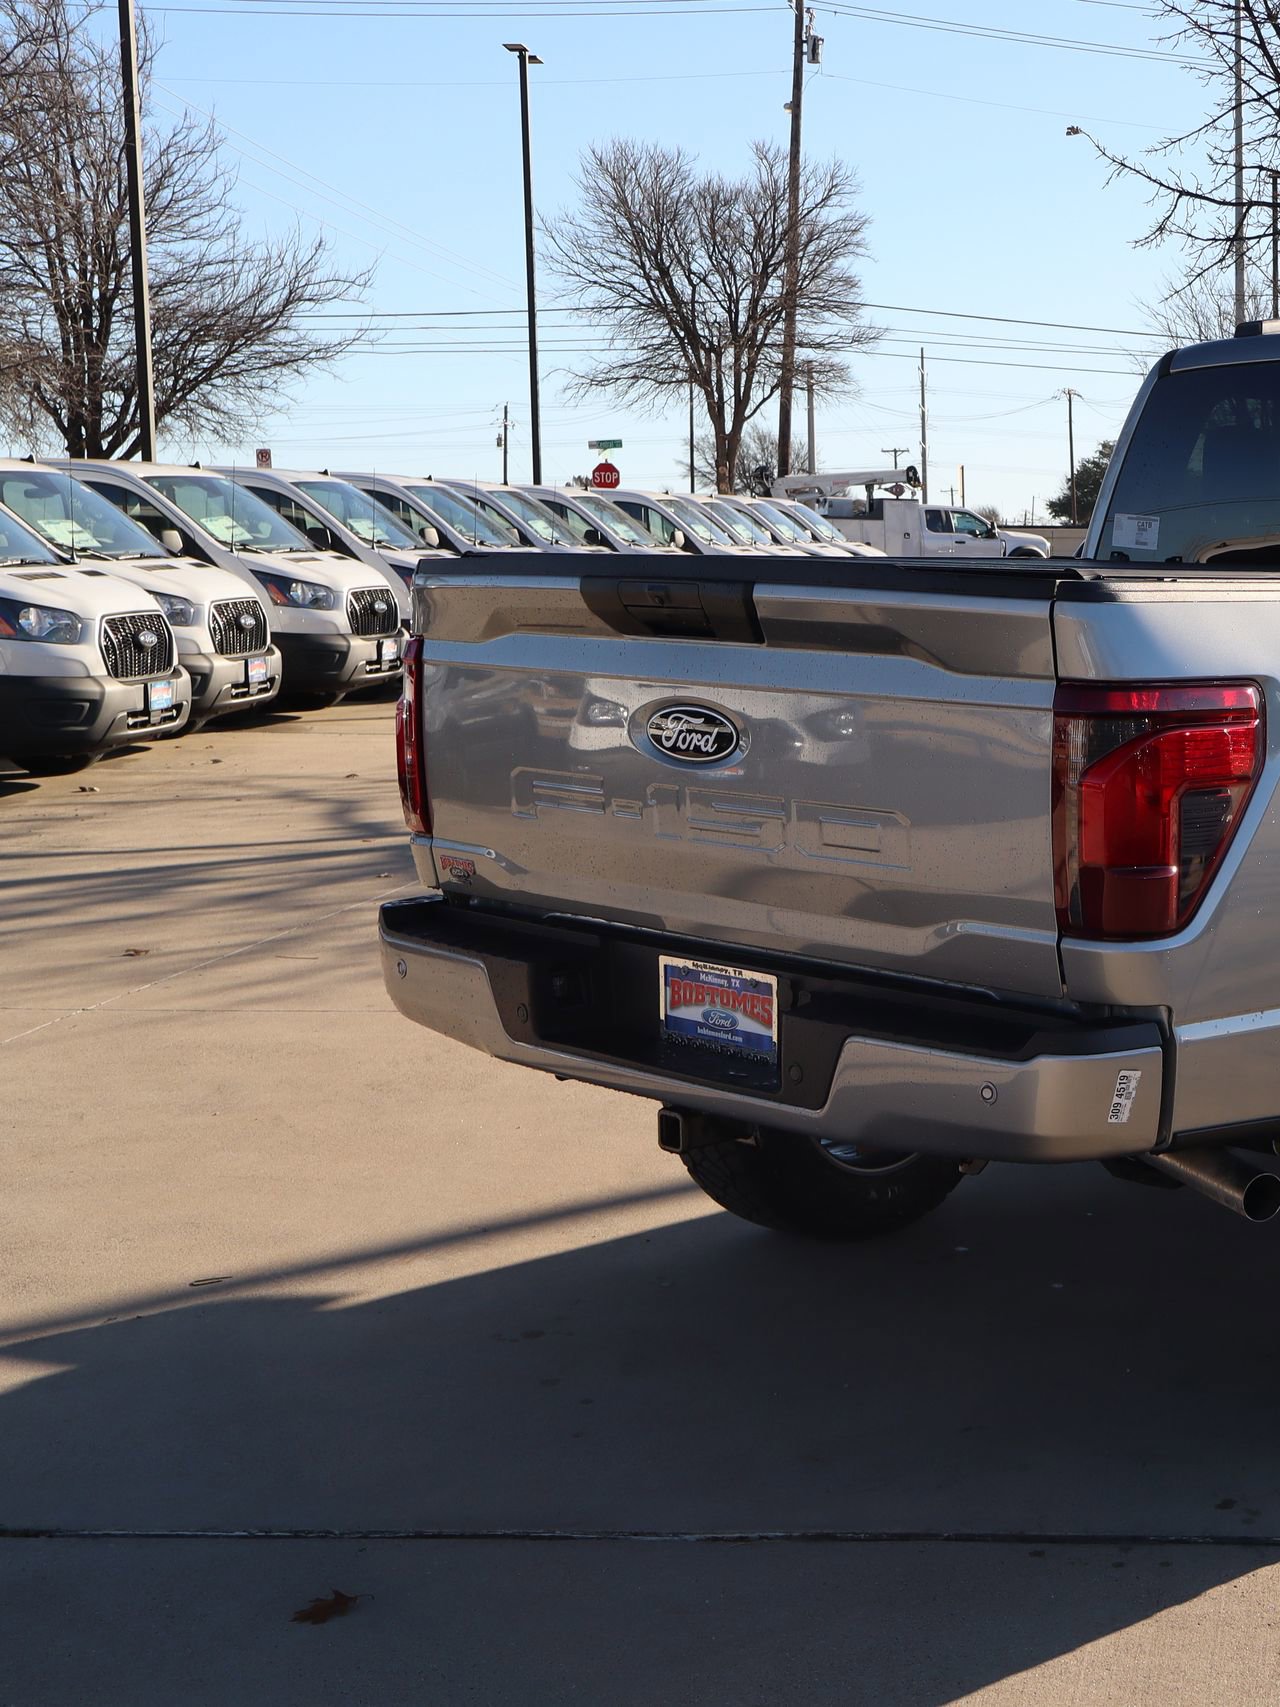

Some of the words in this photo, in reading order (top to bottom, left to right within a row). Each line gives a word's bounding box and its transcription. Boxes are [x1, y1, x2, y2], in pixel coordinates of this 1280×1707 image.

[594, 472, 618, 483] STOP
[661, 712, 719, 753] Ford
[510, 766, 912, 870] F-150
[699, 972, 729, 987] McKinney,
[731, 978, 740, 988] TX
[708, 1011, 732, 1028] Ford
[1115, 1075, 1129, 1099] 4519
[1109, 1102, 1122, 1120] 309
